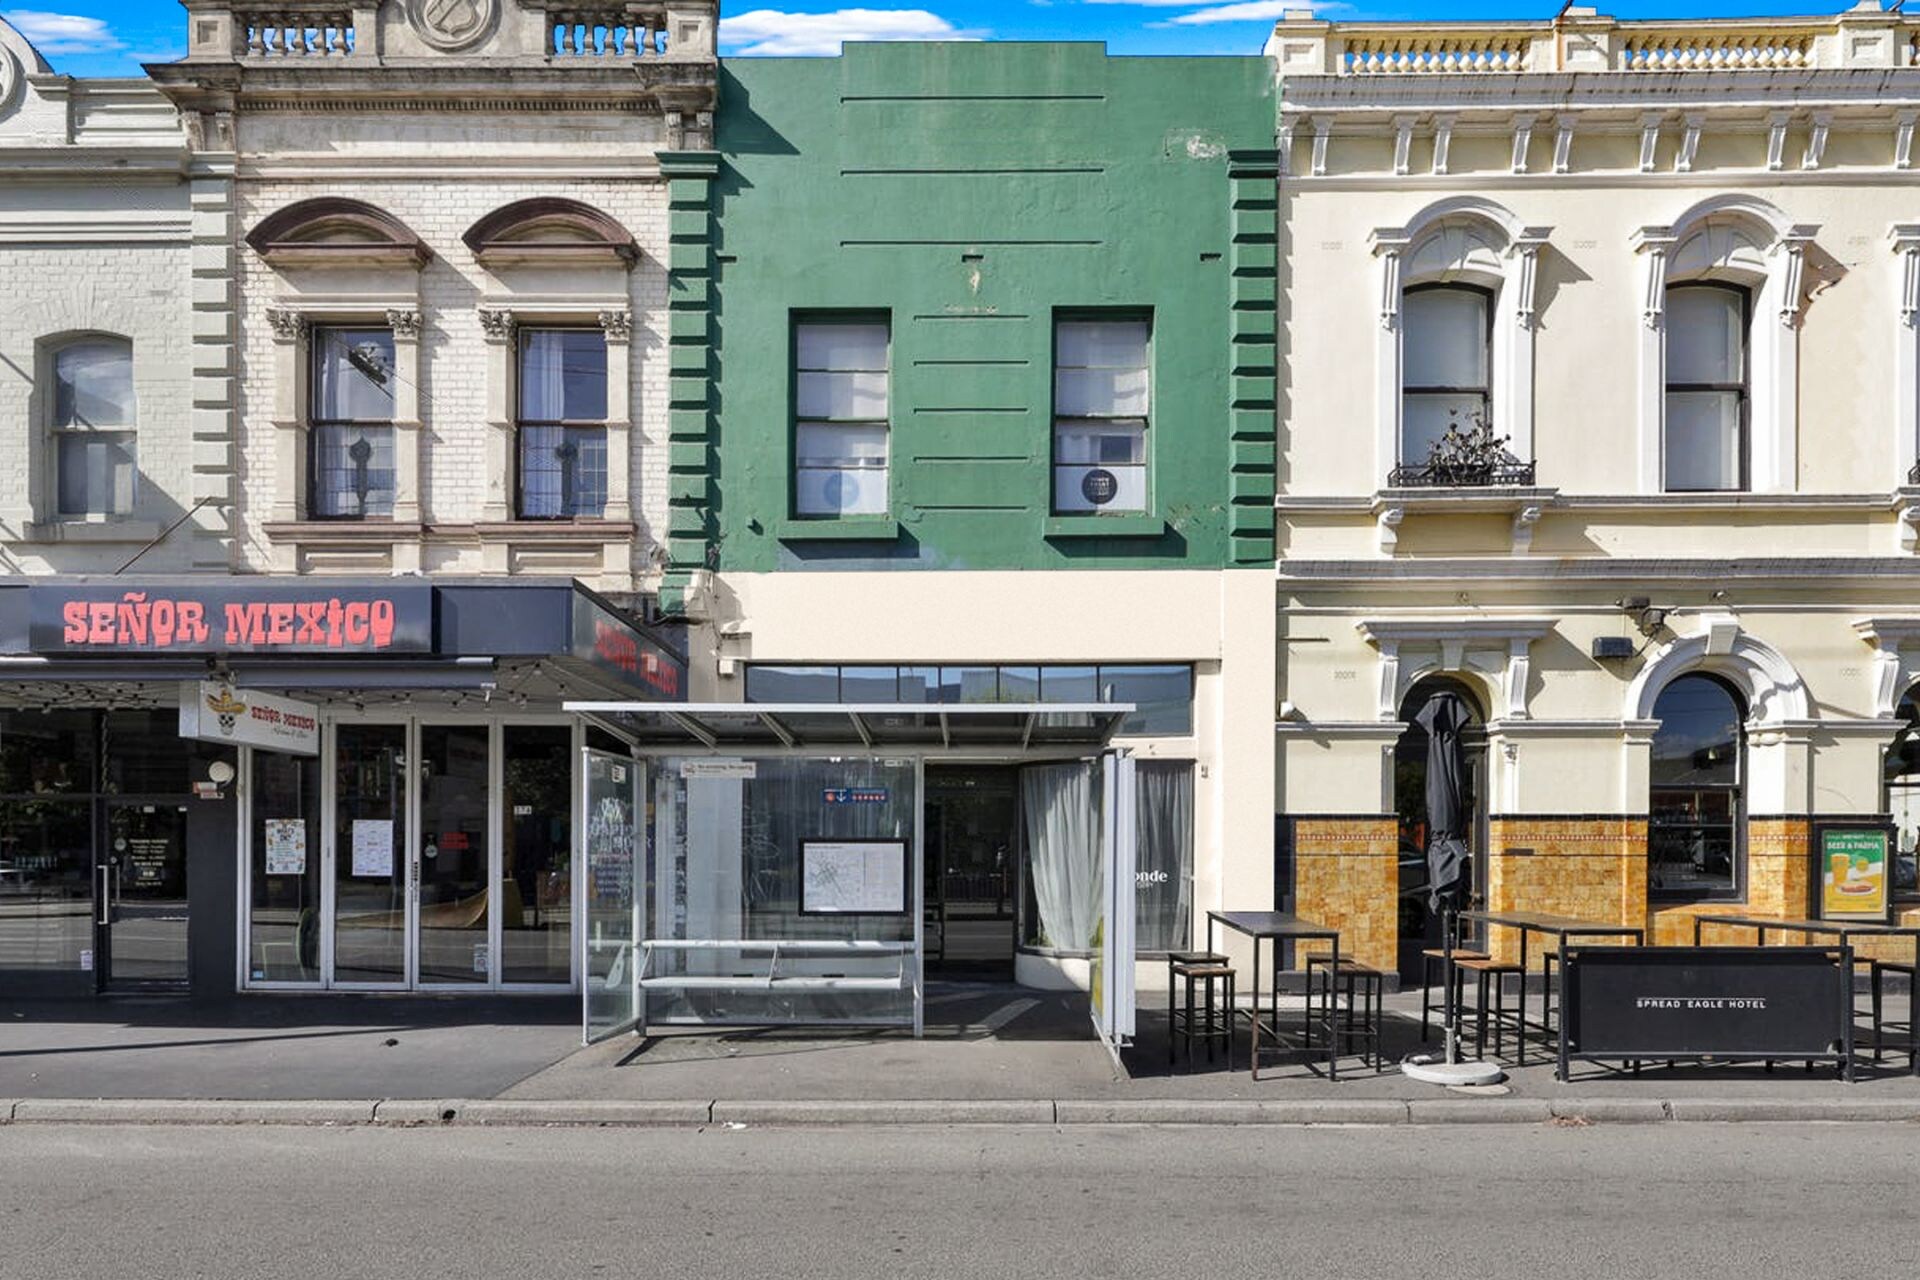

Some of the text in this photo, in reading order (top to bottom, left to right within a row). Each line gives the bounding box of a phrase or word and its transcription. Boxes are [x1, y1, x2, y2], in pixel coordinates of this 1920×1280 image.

[64, 593, 209, 645] SEÑOR
[1636, 1000, 1766, 1008] SPREAD EAGLE HOTEL
